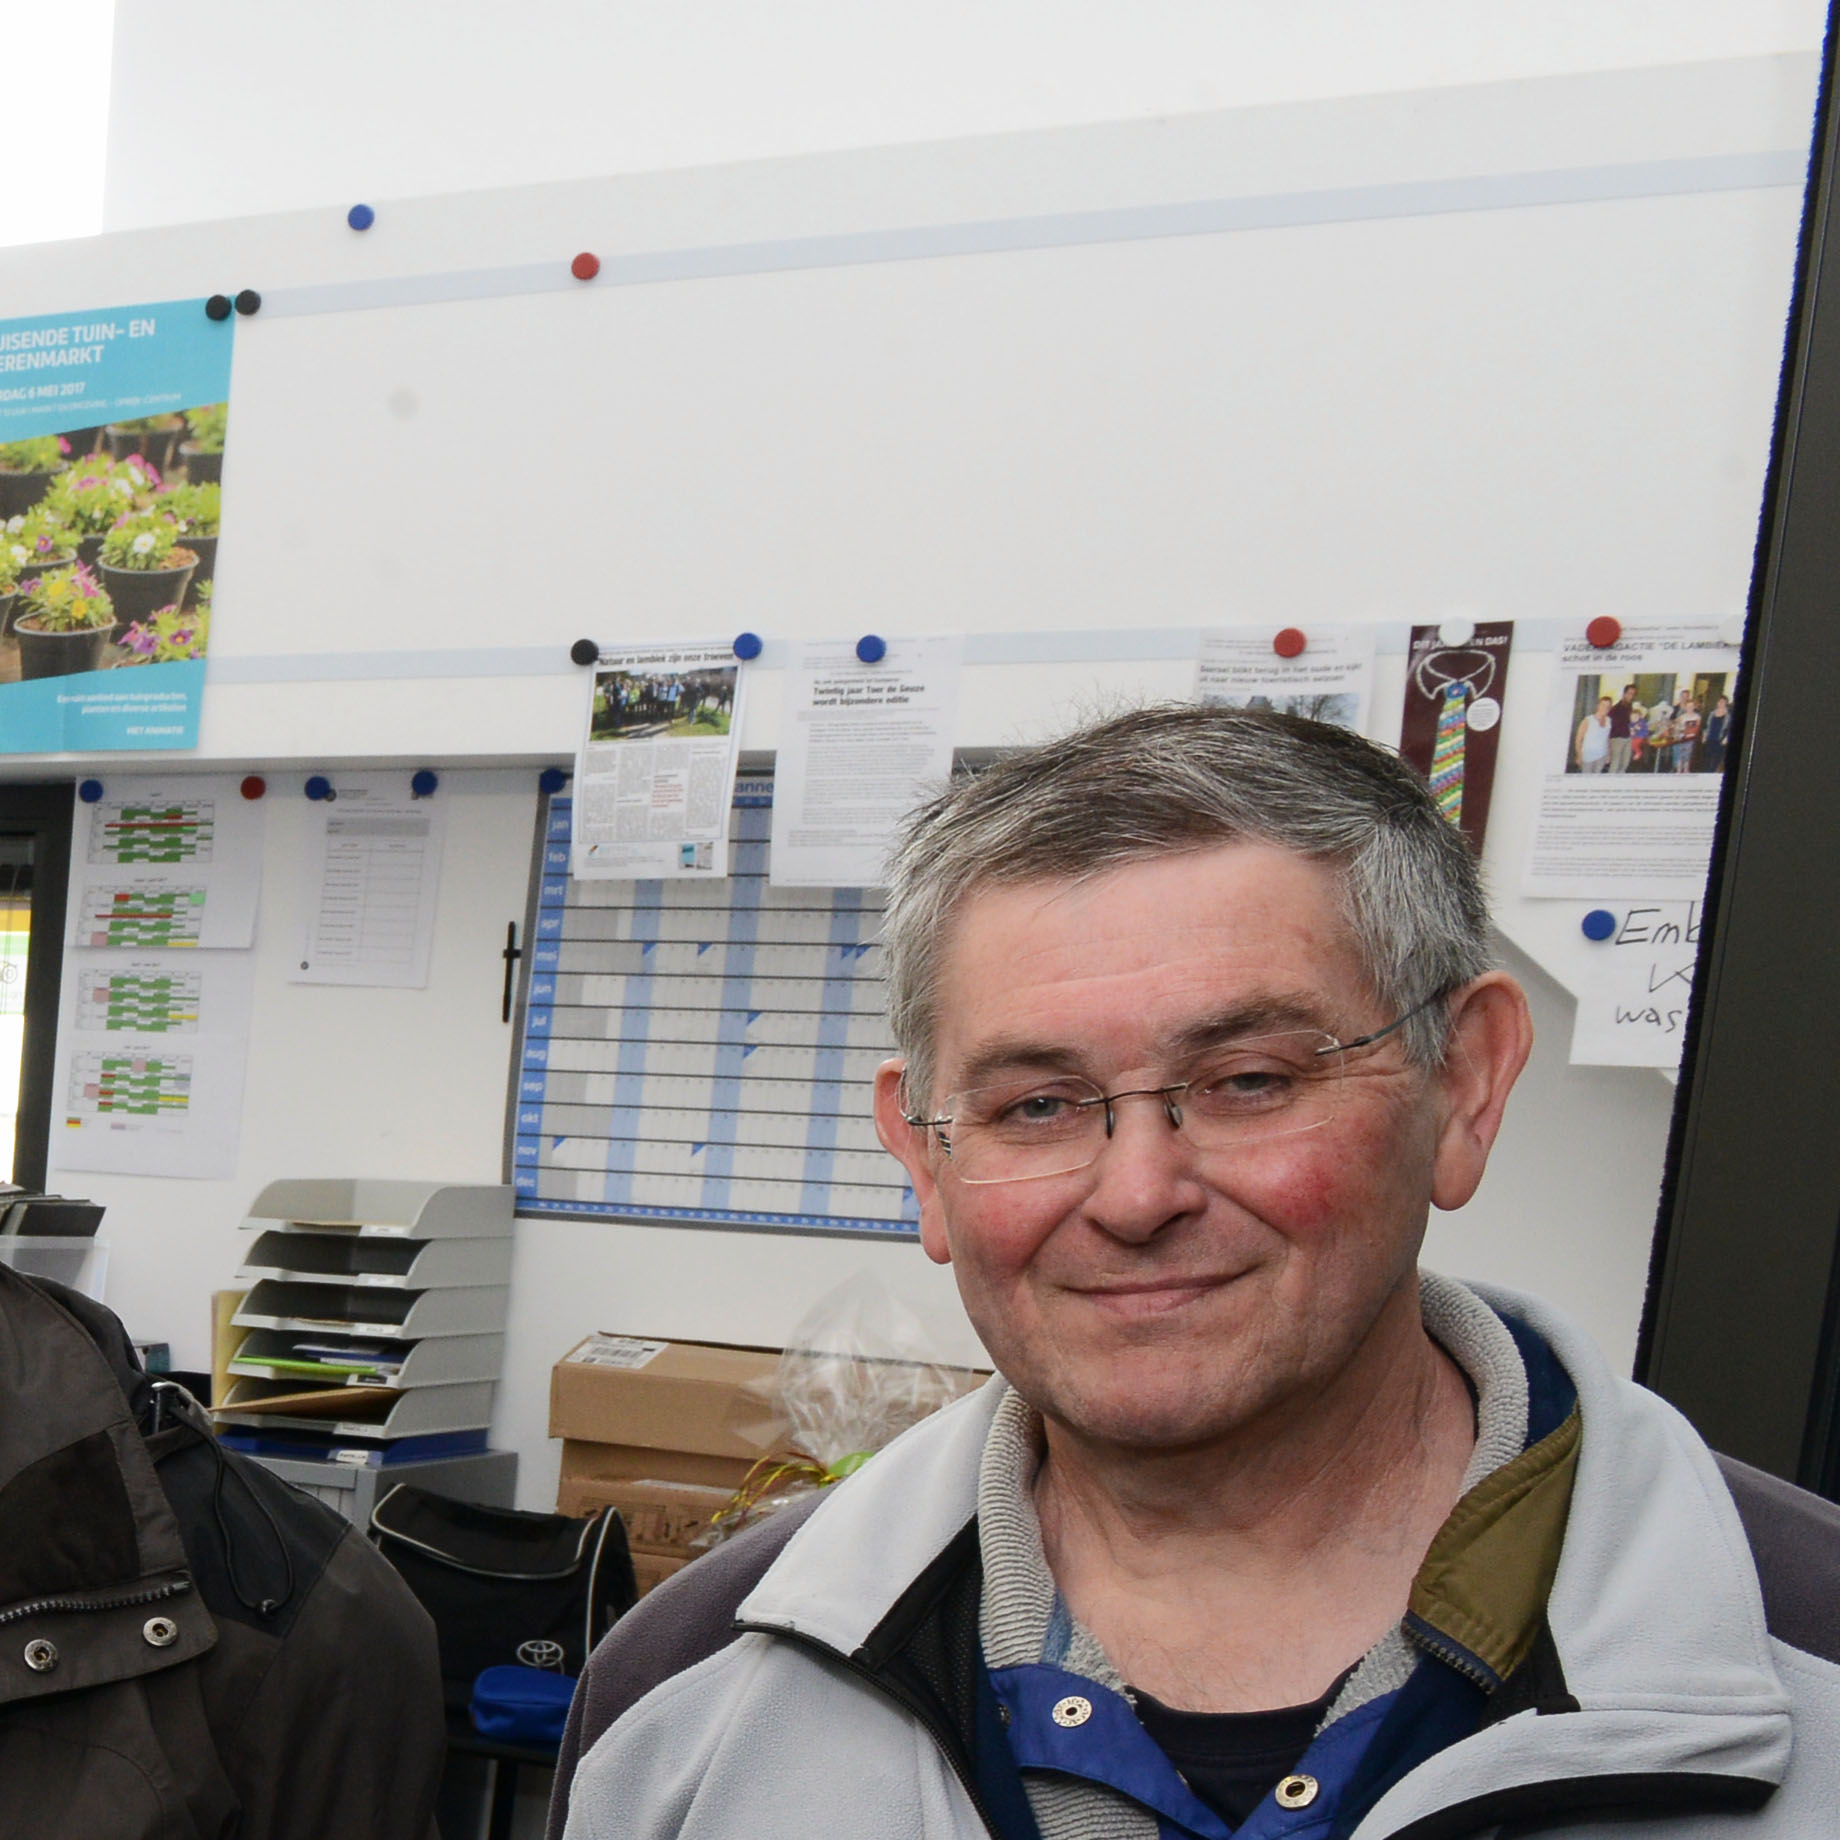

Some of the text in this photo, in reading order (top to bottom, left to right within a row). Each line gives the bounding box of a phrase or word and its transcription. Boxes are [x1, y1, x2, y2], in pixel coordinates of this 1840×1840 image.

[71, 323, 125, 343] TUIN-
[129, 319, 155, 338] EN
[29, 386, 35, 398] 6
[37, 384, 59, 396] MEI
[61, 382, 86, 395] 2017
[552, 819, 568, 833] jan
[549, 852, 566, 862] feb
[545, 885, 563, 895] mrt
[541, 919, 559, 930] apr
[537, 951, 557, 961] mei
[534, 983, 552, 995] jun
[526, 1049, 546, 1061] aug
[523, 1081, 543, 1092] sep
[521, 1113, 539, 1123] okt
[519, 1146, 536, 1155] nov
[517, 1177, 535, 1187] dec
